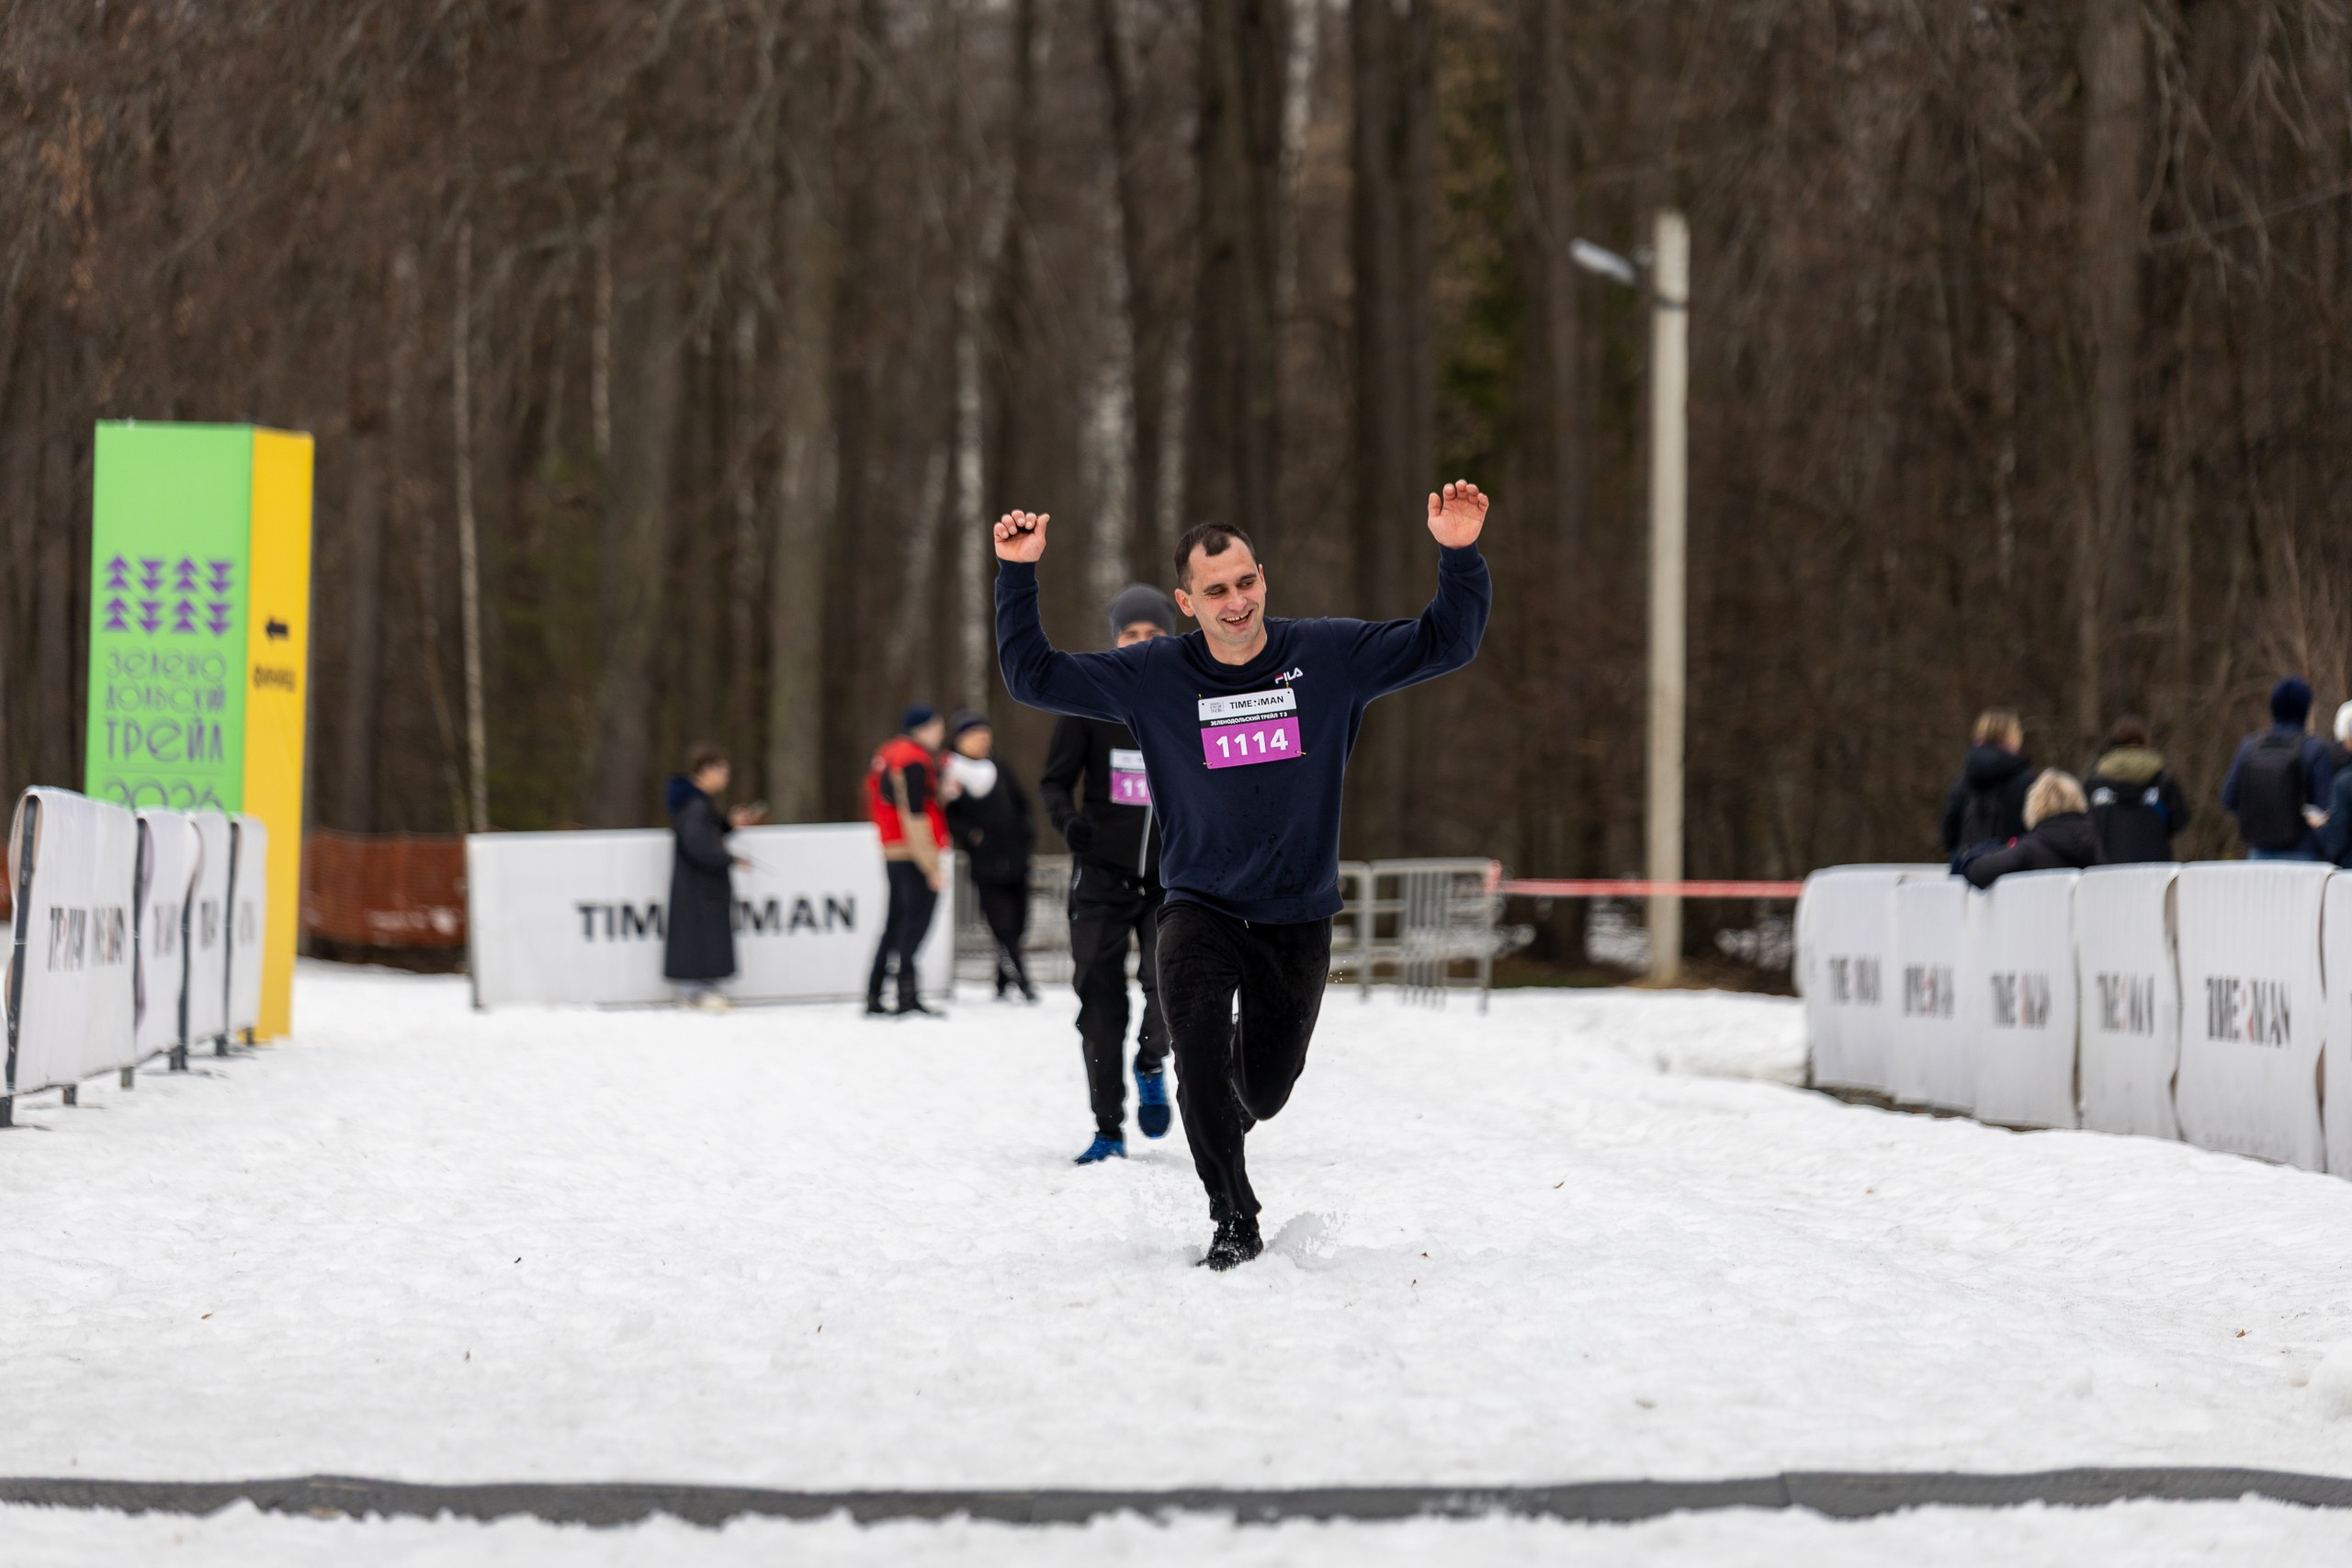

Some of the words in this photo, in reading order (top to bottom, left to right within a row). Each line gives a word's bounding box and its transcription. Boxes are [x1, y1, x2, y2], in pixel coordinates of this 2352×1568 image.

[1273, 667, 1304, 683] FILA
[1210, 715, 1261, 727] ЗЕЛЕНОДОЛЬСКИЙ
[1261, 712, 1278, 721] ТРЕЙЛ
[1216, 728, 1289, 758] 1114
[1122, 778, 1148, 797] 11
